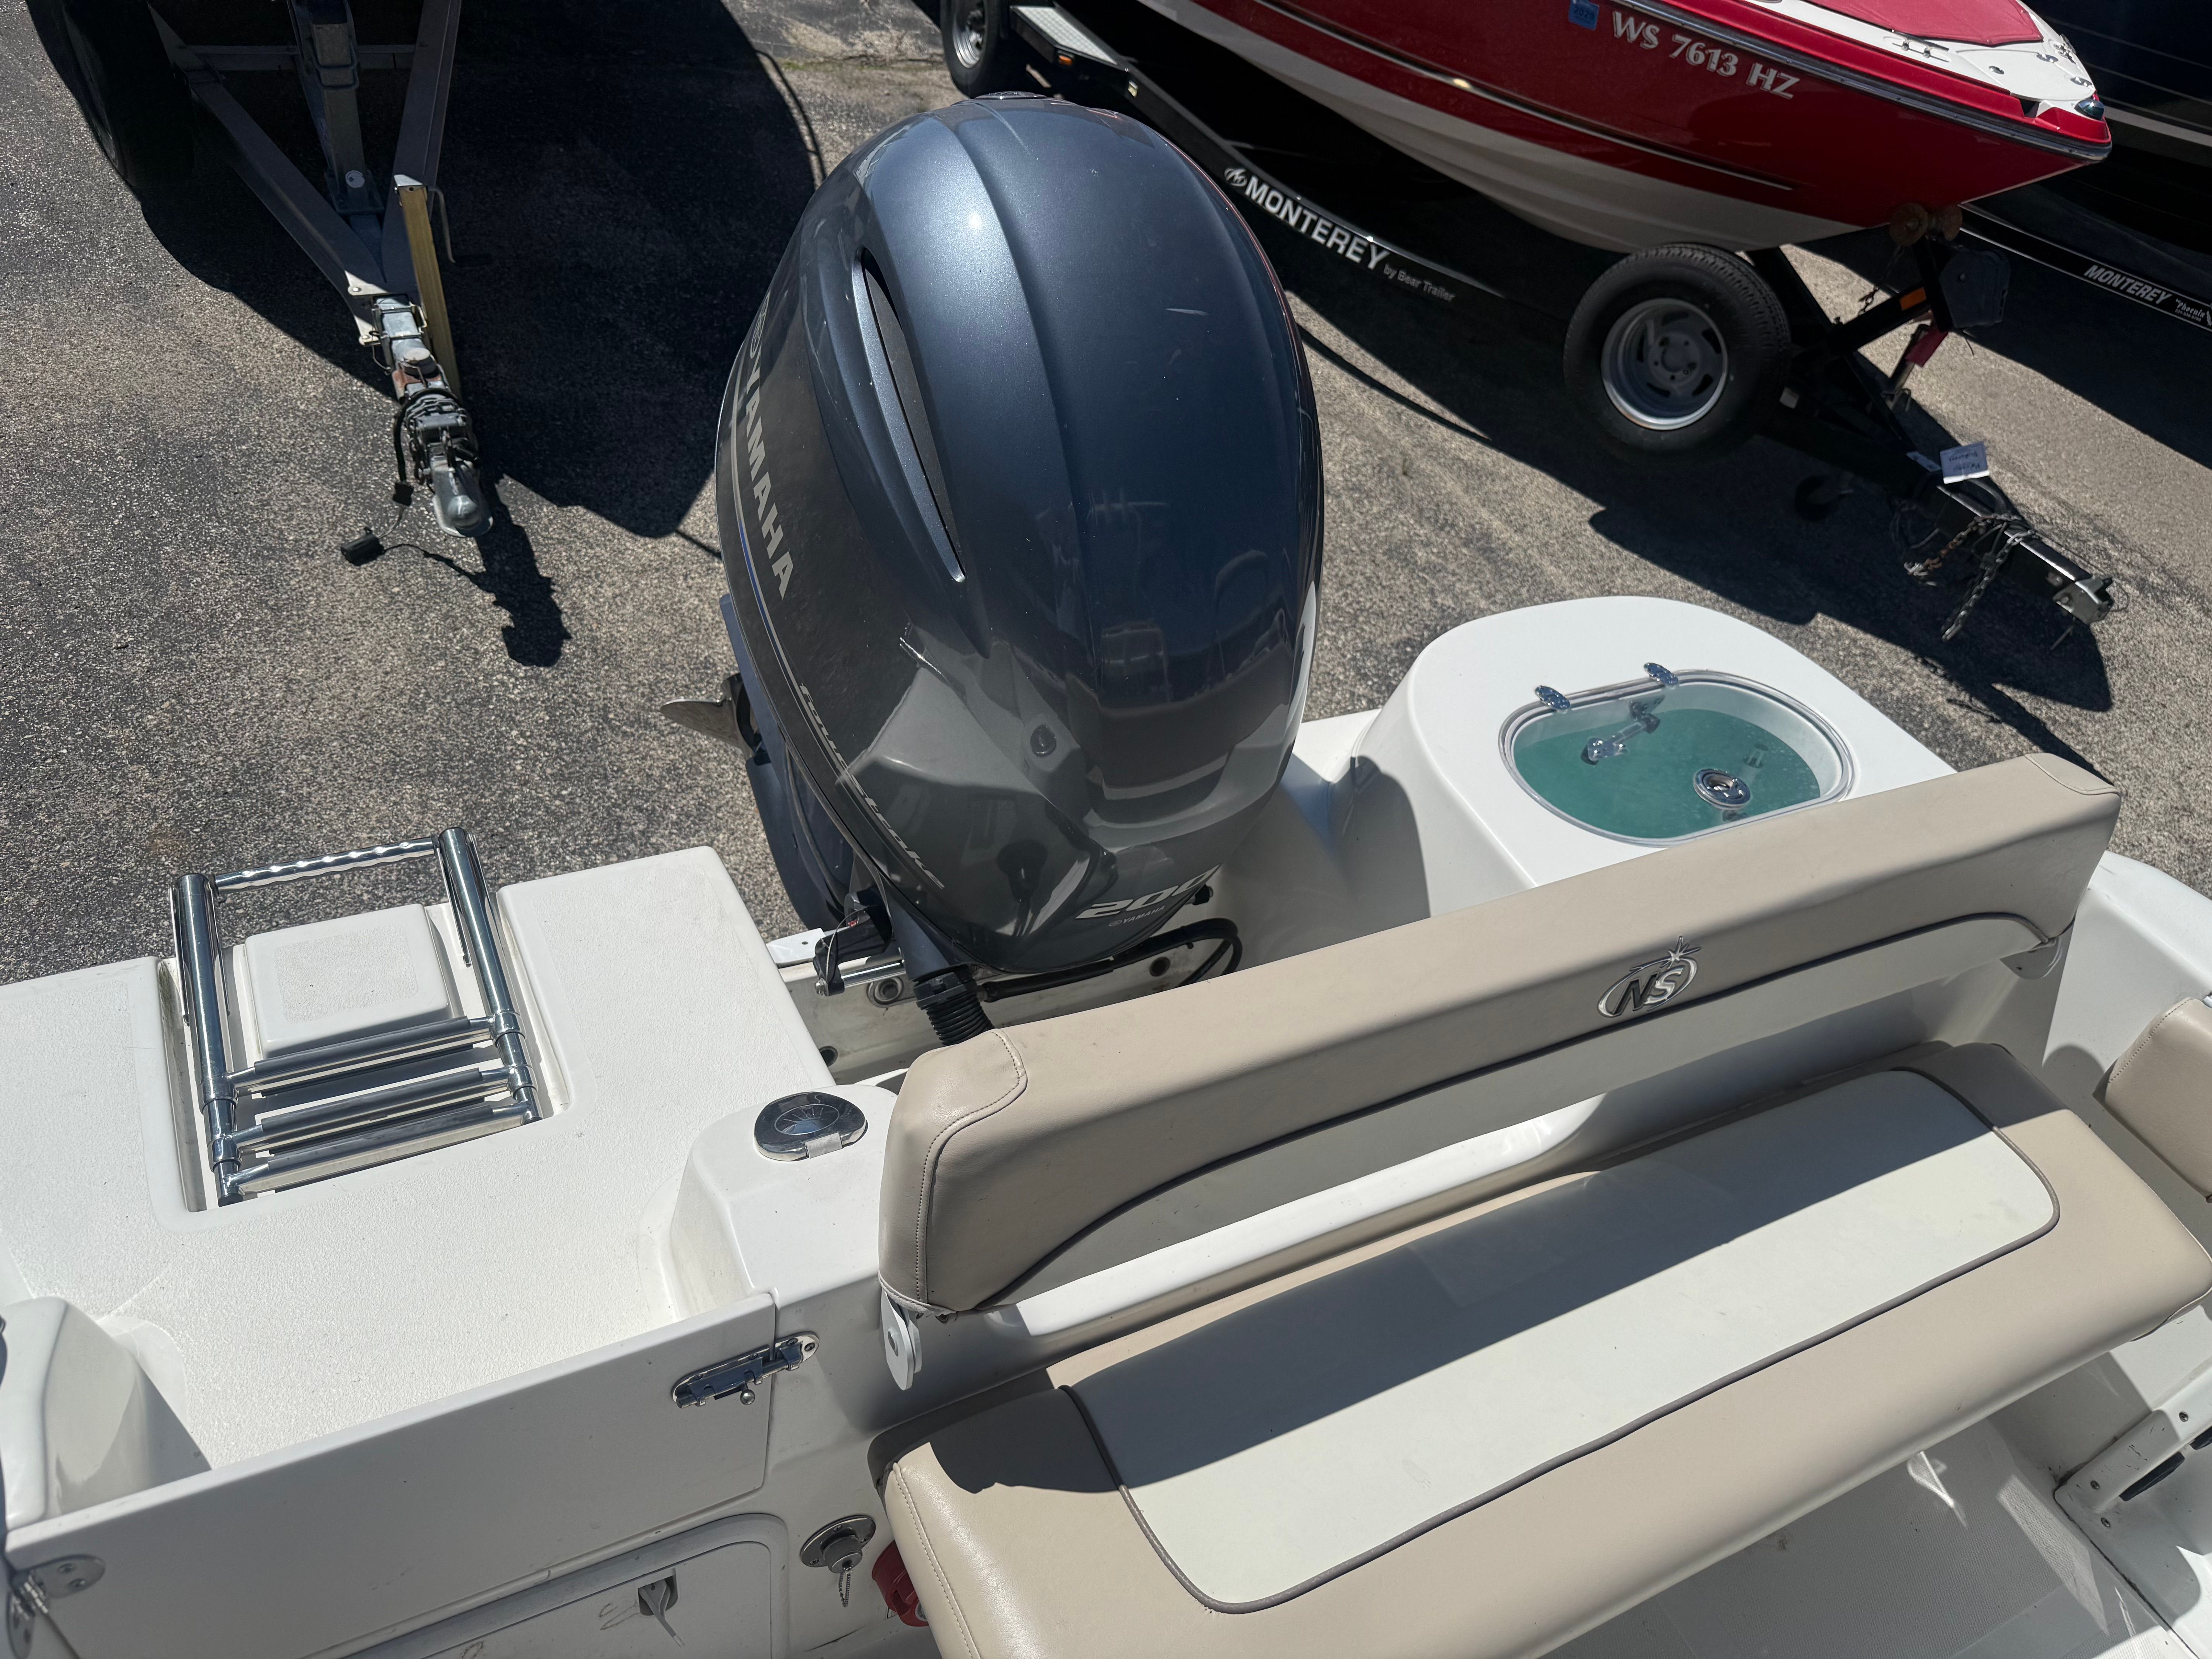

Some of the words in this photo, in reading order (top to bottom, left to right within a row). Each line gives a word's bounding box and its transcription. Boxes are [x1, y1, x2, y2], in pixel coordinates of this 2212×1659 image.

[1613, 11, 1660, 49] WS
[1669, 34, 1738, 77] 7613
[1746, 63, 1800, 100] HZ
[1245, 176, 1391, 270] MONTEREY
[1384, 264, 1396, 279] by
[1397, 271, 1422, 288] Bear
[1422, 280, 1456, 302] Trailer
[2083, 265, 2172, 304] MONTEREY
[747, 344, 793, 600] YAMAHA
[1075, 864, 1221, 919] 200
[1122, 905, 1165, 924] YAMAHA
